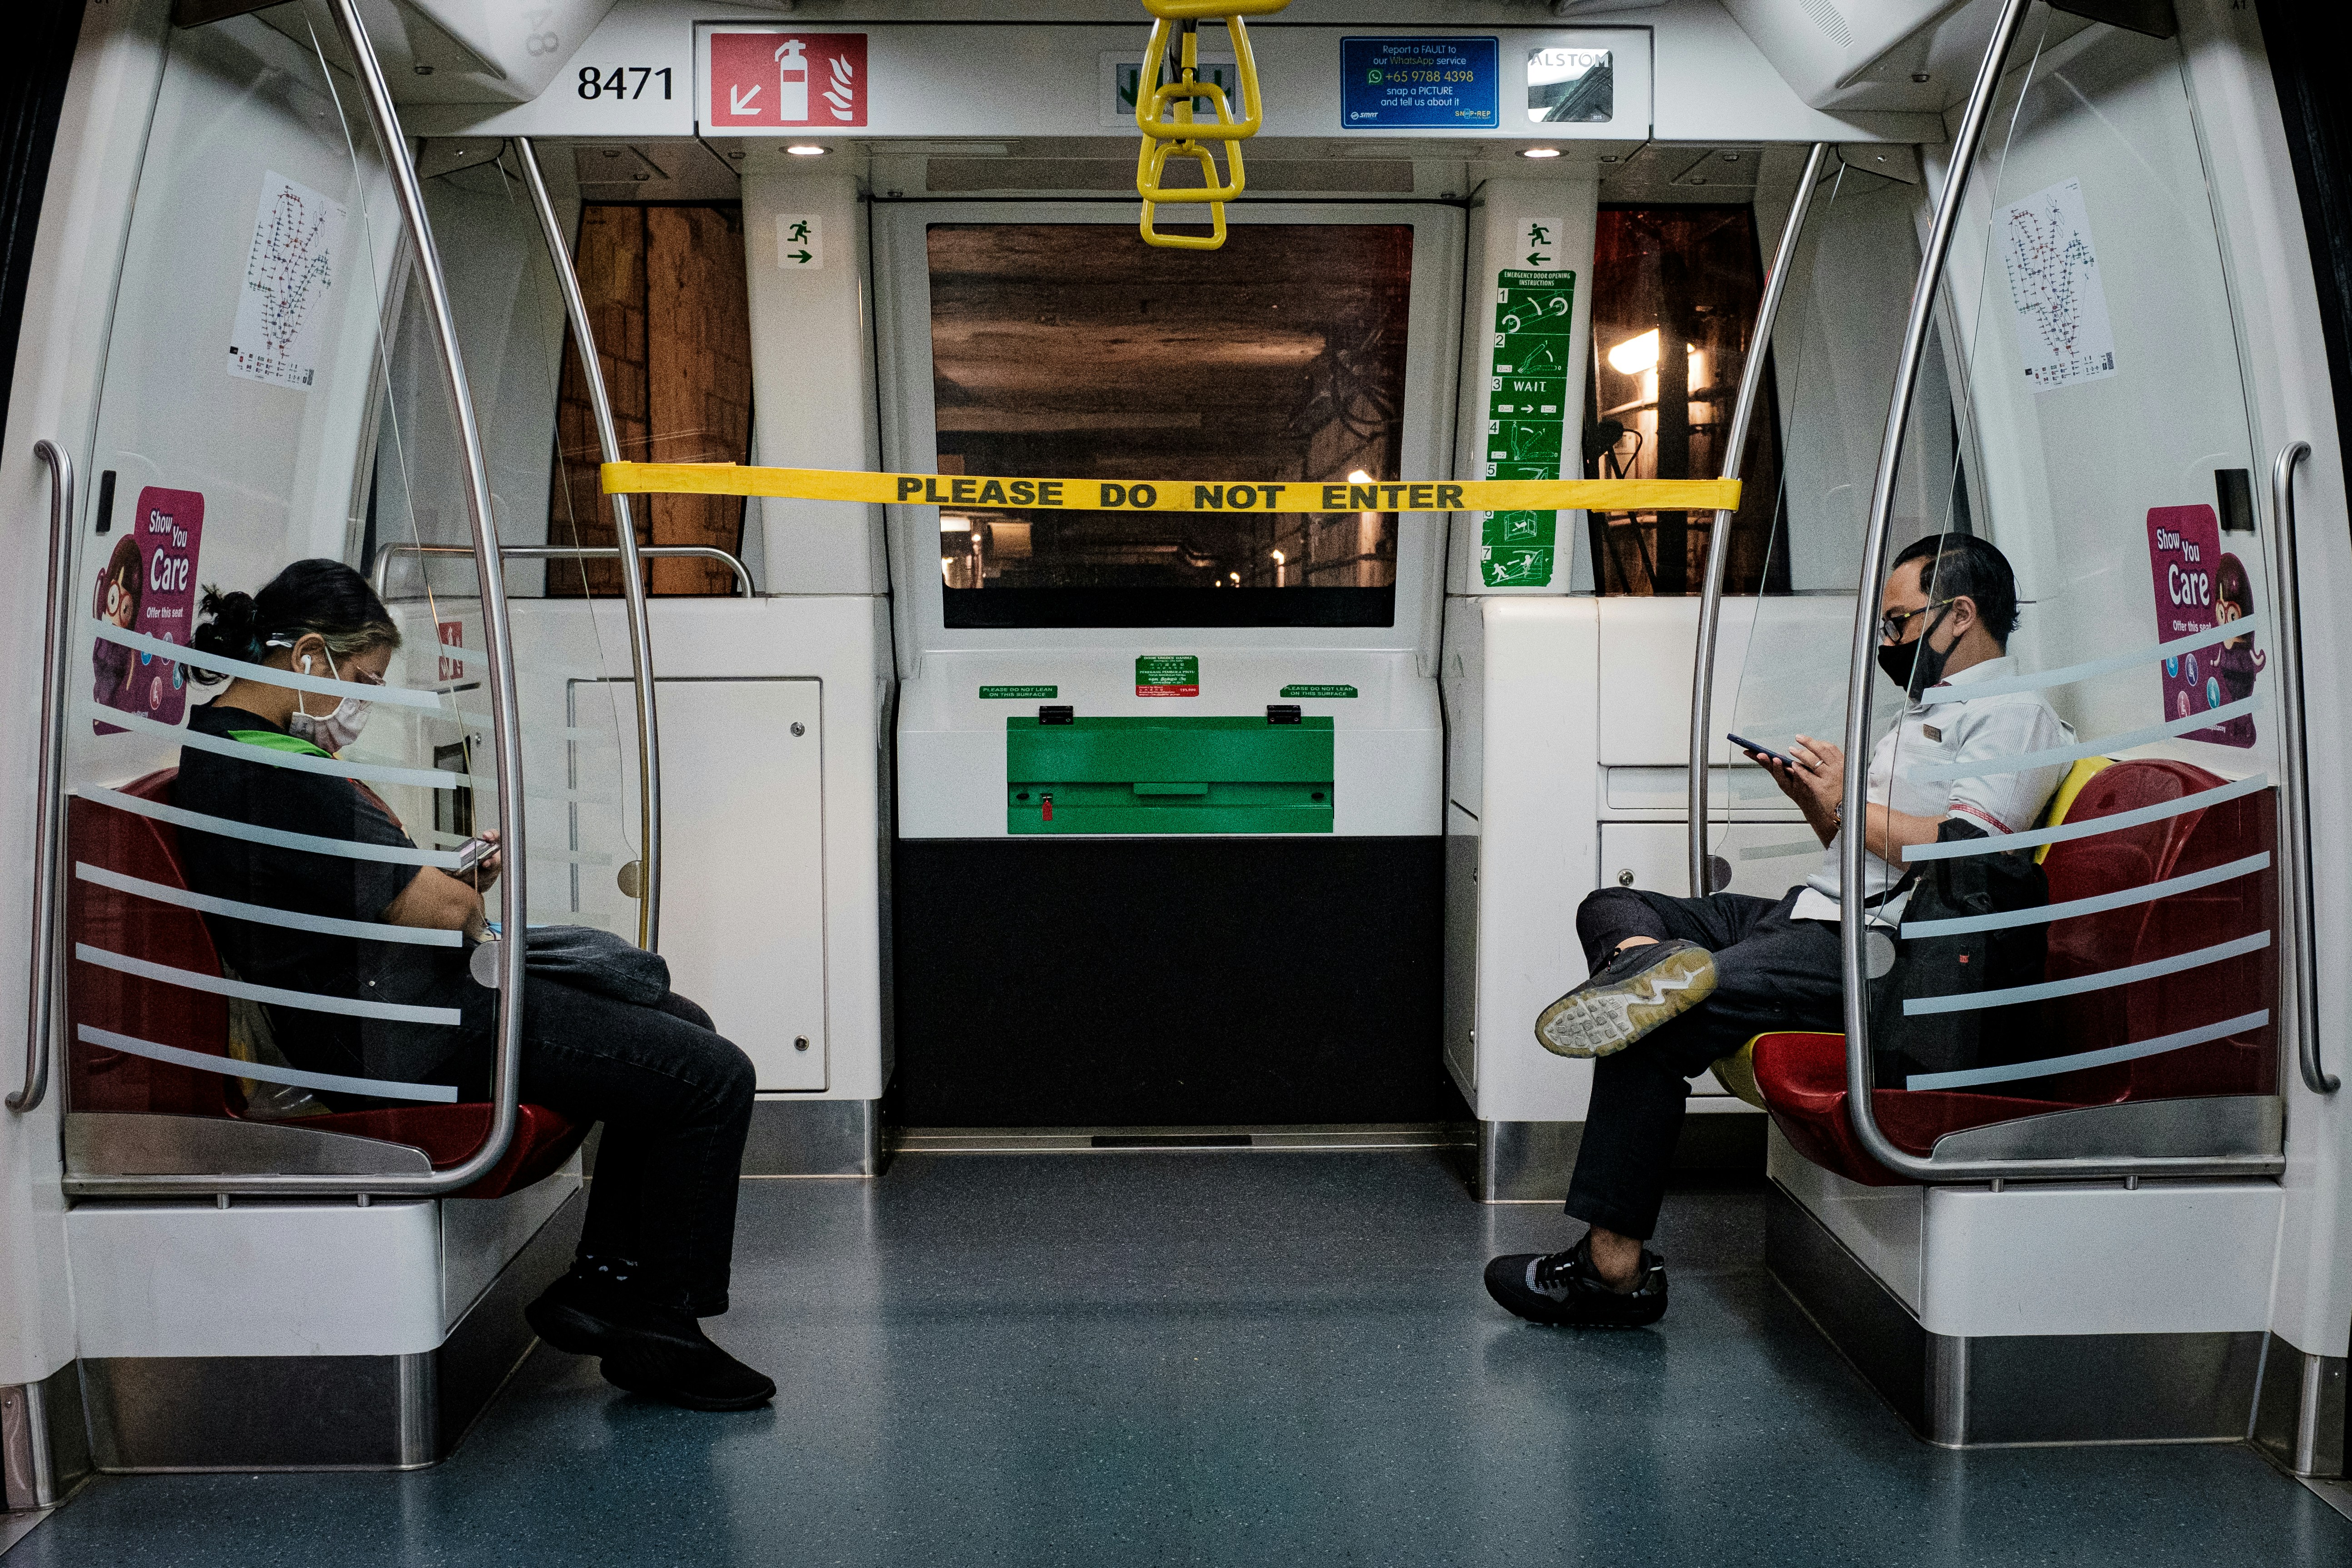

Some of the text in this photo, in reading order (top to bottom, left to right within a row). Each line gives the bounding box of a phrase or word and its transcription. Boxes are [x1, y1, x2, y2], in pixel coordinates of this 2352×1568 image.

[1383, 45, 1411, 55] Report
[1422, 45, 1446, 54] FAULT
[1448, 45, 1456, 54] to
[1390, 56, 1434, 65] WhatsApp
[1437, 56, 1466, 65] service
[1530, 52, 1609, 68] ALSTOM
[1386, 71, 1474, 82] +65 9788 4398
[578, 67, 672, 100] 8471
[1387, 88, 1408, 97] snap
[1419, 86, 1453, 95] PICTURE
[1380, 97, 1397, 106] and
[1400, 97, 1412, 106] tell
[1427, 97, 1452, 106] about
[1454, 97, 1459, 106] it
[1500, 290, 1505, 302] 1
[1495, 334, 1504, 346] 2
[1493, 378, 1500, 390] 3
[1514, 381, 1547, 392] WAIT
[1490, 422, 1498, 433] 4
[1487, 464, 1495, 475] 5
[897, 477, 1465, 509] PLEASE DO NOT ENTER
[149, 510, 188, 548] Show You
[2157, 528, 2200, 562] Show You
[1483, 548, 1490, 558] 7
[151, 548, 189, 591] Care
[2168, 564, 2210, 606] Care
[147, 607, 183, 618] Offer this seat
[2173, 620, 2212, 632] Offer this seat
